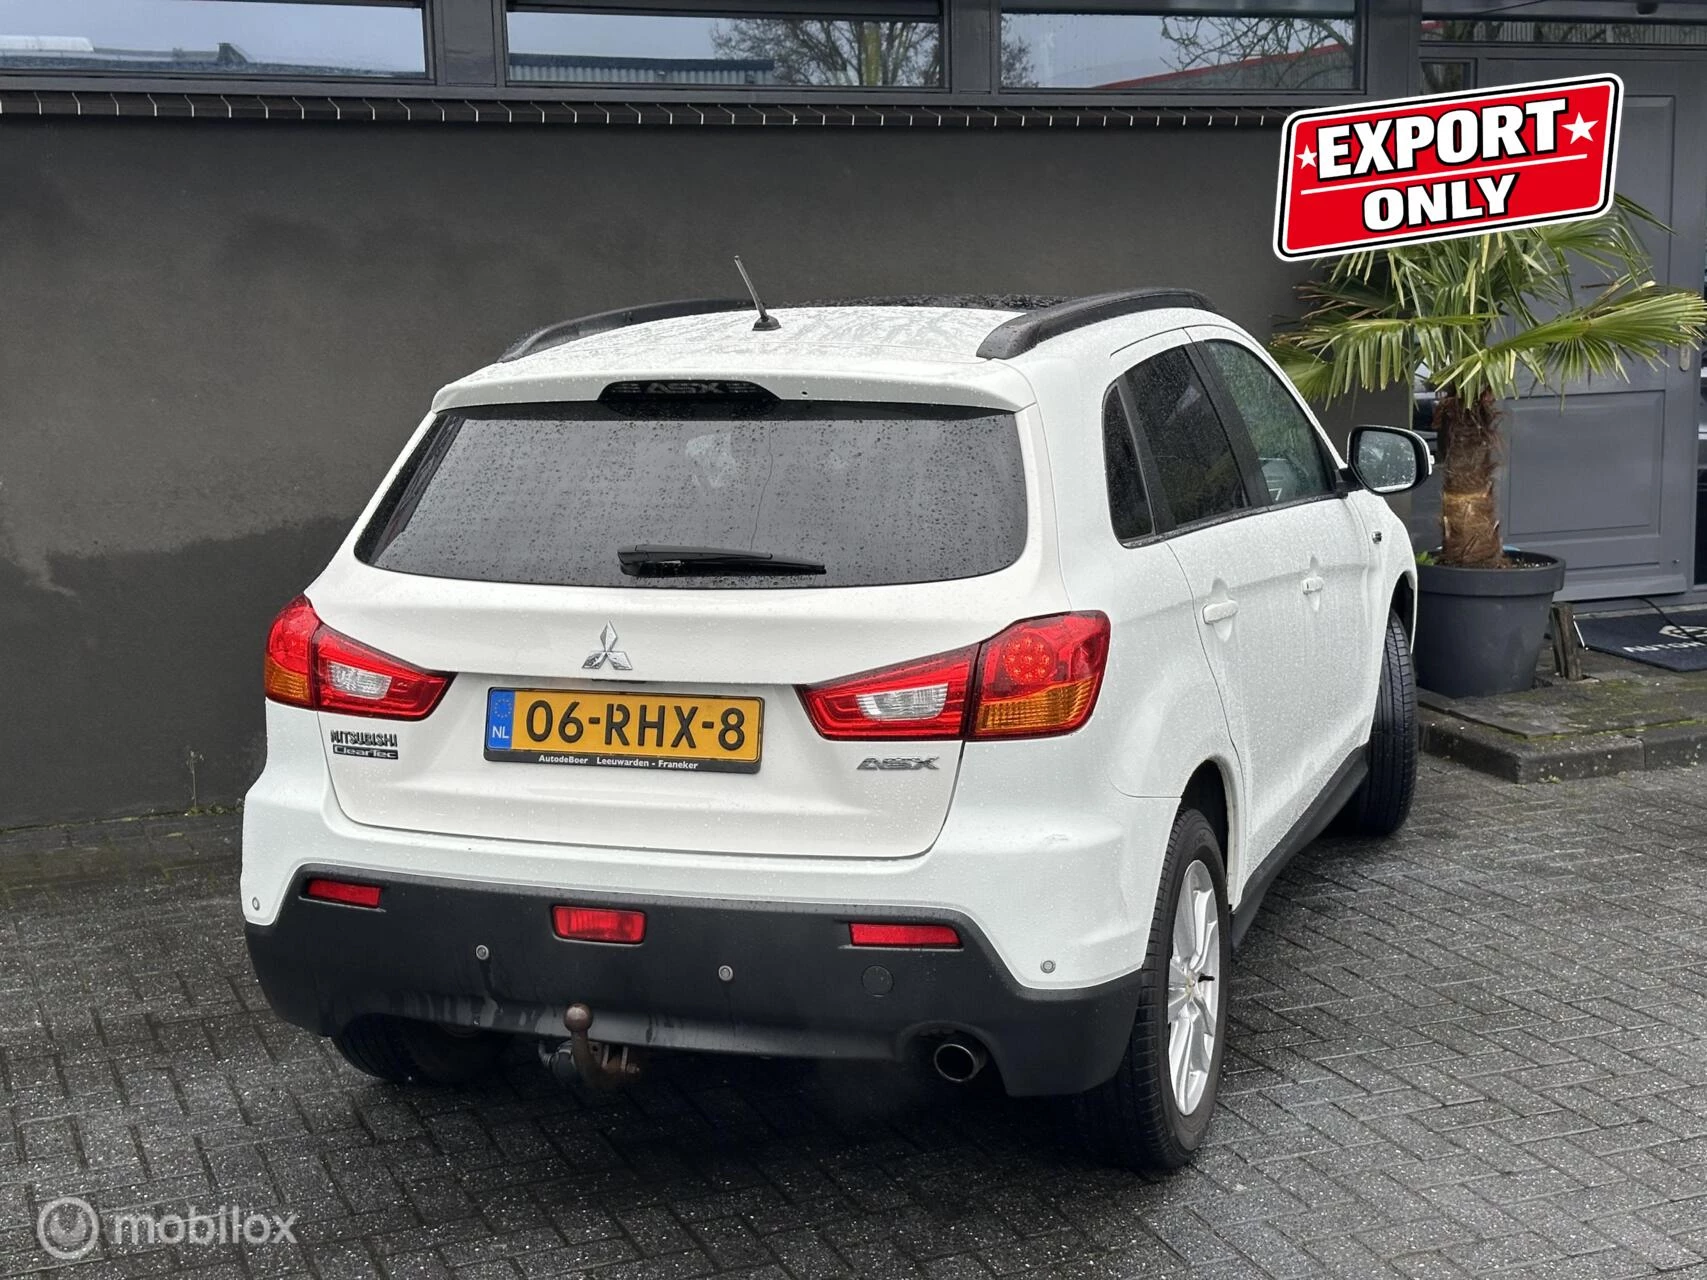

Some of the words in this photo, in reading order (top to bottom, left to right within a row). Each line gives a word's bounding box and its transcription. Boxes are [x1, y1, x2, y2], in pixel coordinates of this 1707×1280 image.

[646, 382, 724, 394] ASX
[491, 725, 510, 739] NL
[525, 699, 746, 751] 06-RHX-8
[330, 730, 398, 747] MITSUBISHI
[333, 744, 398, 759] ClearTec
[538, 754, 589, 765] AutodeBoer
[596, 757, 650, 768] Leeuwarden
[657, 760, 699, 770] Franeker
[856, 756, 940, 771] ASX
